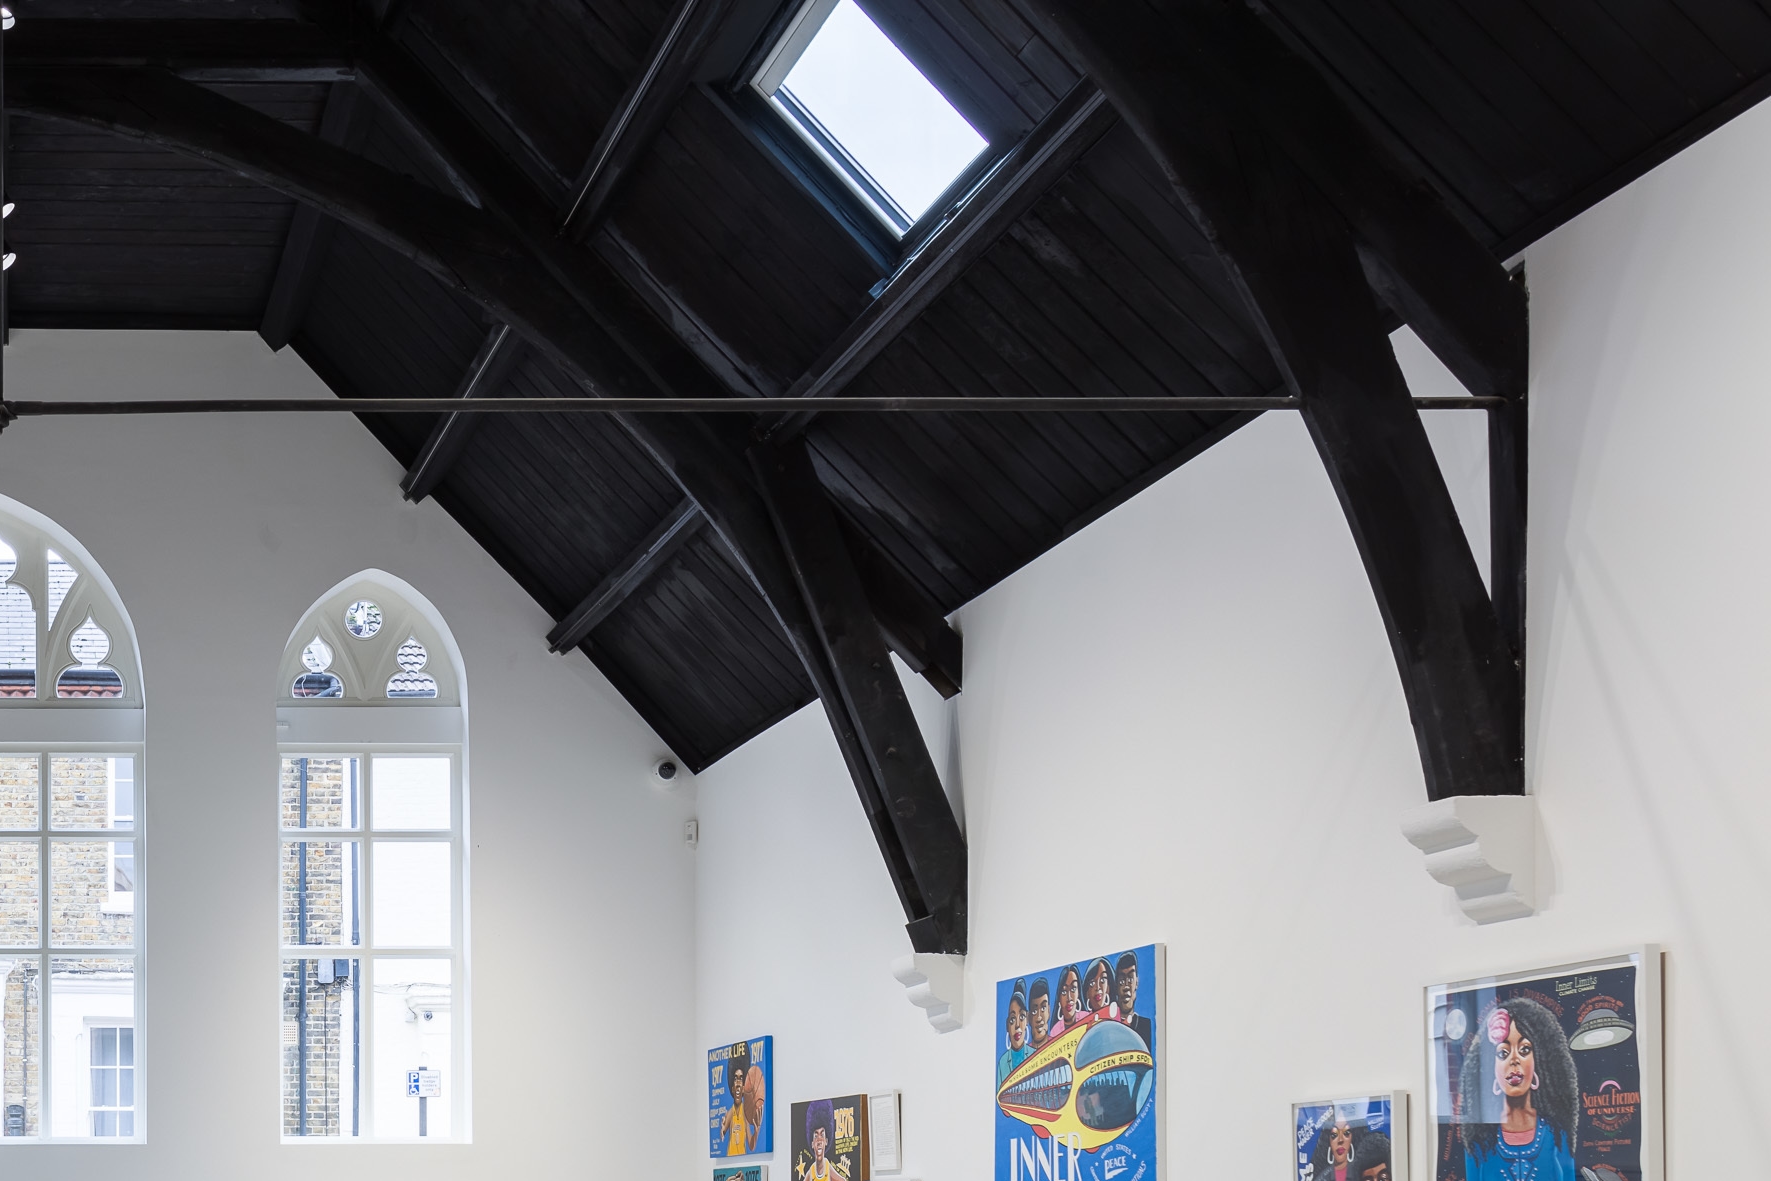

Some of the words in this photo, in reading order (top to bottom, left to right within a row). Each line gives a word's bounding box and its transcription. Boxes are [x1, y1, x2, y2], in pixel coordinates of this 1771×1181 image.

[1555, 980, 1573, 992] Inner
[1574, 975, 1597, 990] Limits
[1559, 989, 1578, 997] CLIMATE
[1578, 985, 1596, 993] CHANGE
[708, 1045, 732, 1063] ANOTHER
[733, 1042, 746, 1058] LIFE
[750, 1040, 764, 1065] 1977
[1008, 1063, 1039, 1084] WHOLESOME
[1040, 1039, 1078, 1065] ENCOUNTERS
[1089, 1058, 1116, 1074] CITIZEN
[1118, 1054, 1134, 1064] SHIP
[411, 1072, 419, 1083] P
[711, 1065, 724, 1088] 1977
[1582, 1092, 1610, 1108] SCIENCE
[1611, 1088, 1641, 1104] FICTION
[1124, 1119, 1142, 1138] WILLIAM
[1140, 1097, 1154, 1119] SCOTT
[1587, 1108, 1597, 1116] OF
[1597, 1106, 1634, 1115] UNIVERSE
[834, 1106, 855, 1139] 1976
[1297, 1116, 1315, 1139] PEACE
[1115, 1143, 1132, 1156] STATES
[1104, 1156, 1127, 1174] PEACE
